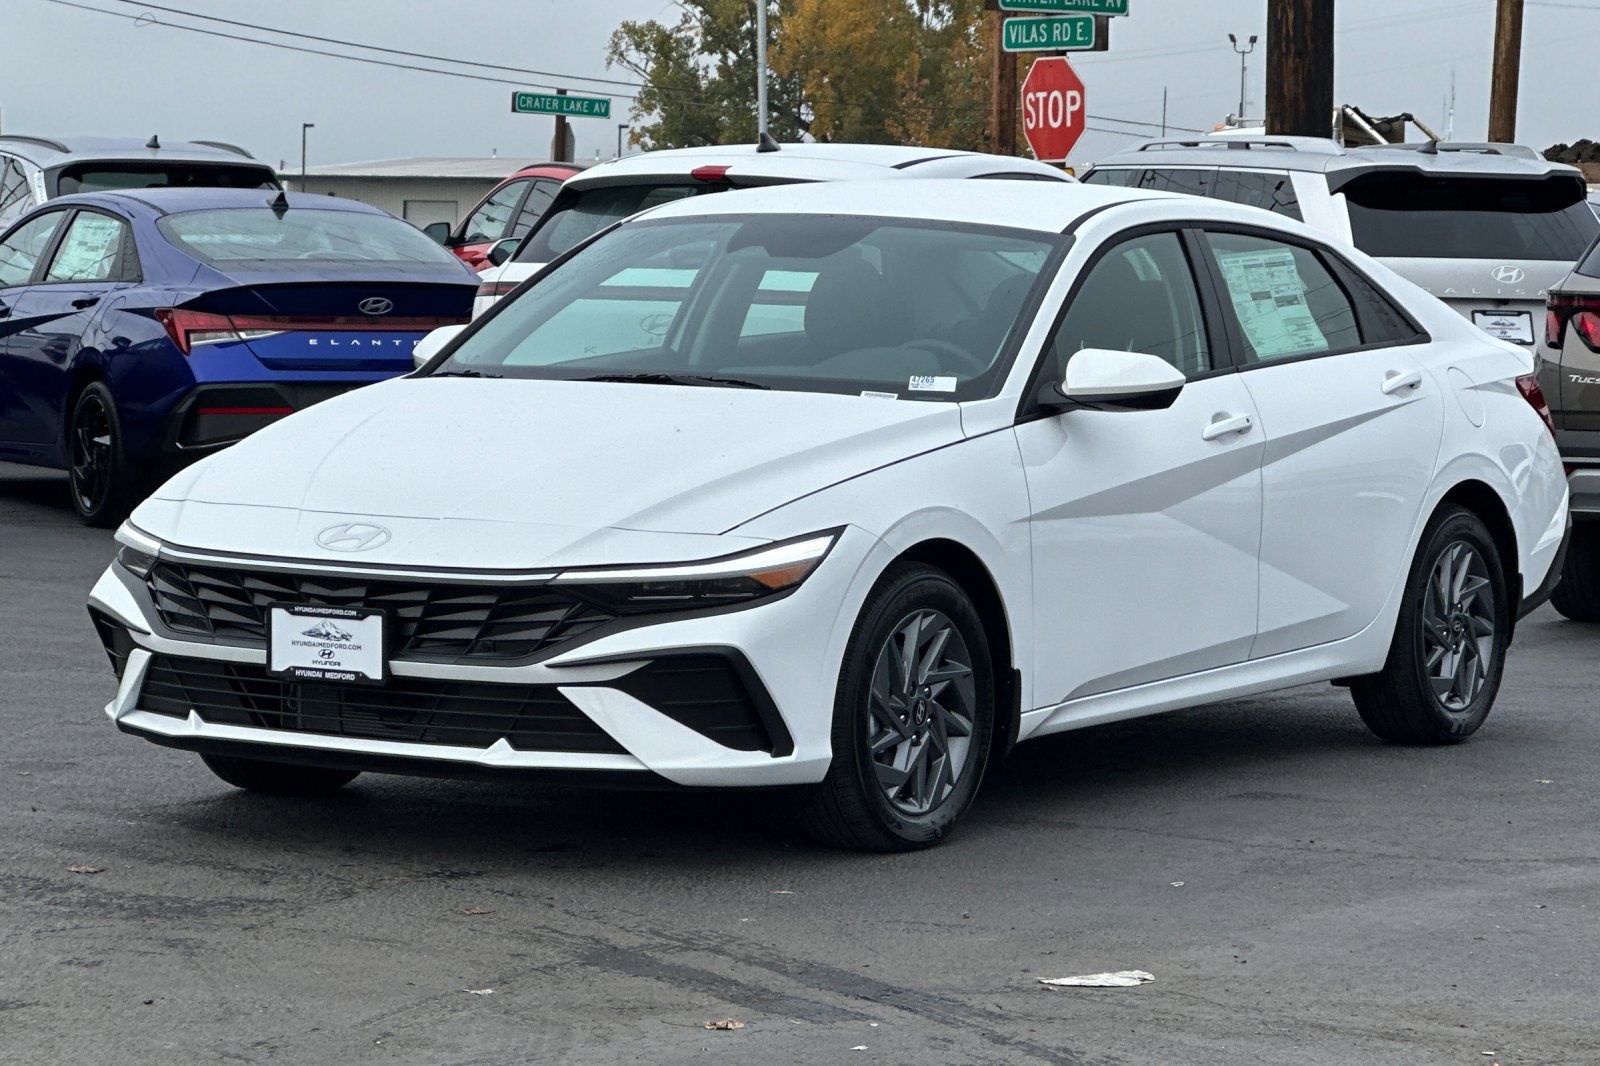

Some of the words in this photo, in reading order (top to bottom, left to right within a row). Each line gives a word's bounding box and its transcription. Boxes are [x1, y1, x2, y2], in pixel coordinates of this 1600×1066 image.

[1009, 24, 1047, 43] VILAS
[1053, 23, 1071, 41] RD
[519, 96, 559, 110] CRATER
[563, 100, 589, 112] LAKE
[593, 102, 607, 113] AV
[1025, 90, 1081, 129] STOP
[294, 606, 357, 616] HYUNDAIMEDFORD.COM
[291, 640, 362, 651] HYUNDAIMEDFORD.COM
[295, 669, 322, 678] HYUNDAI
[324, 671, 355, 681] MEDFORD
